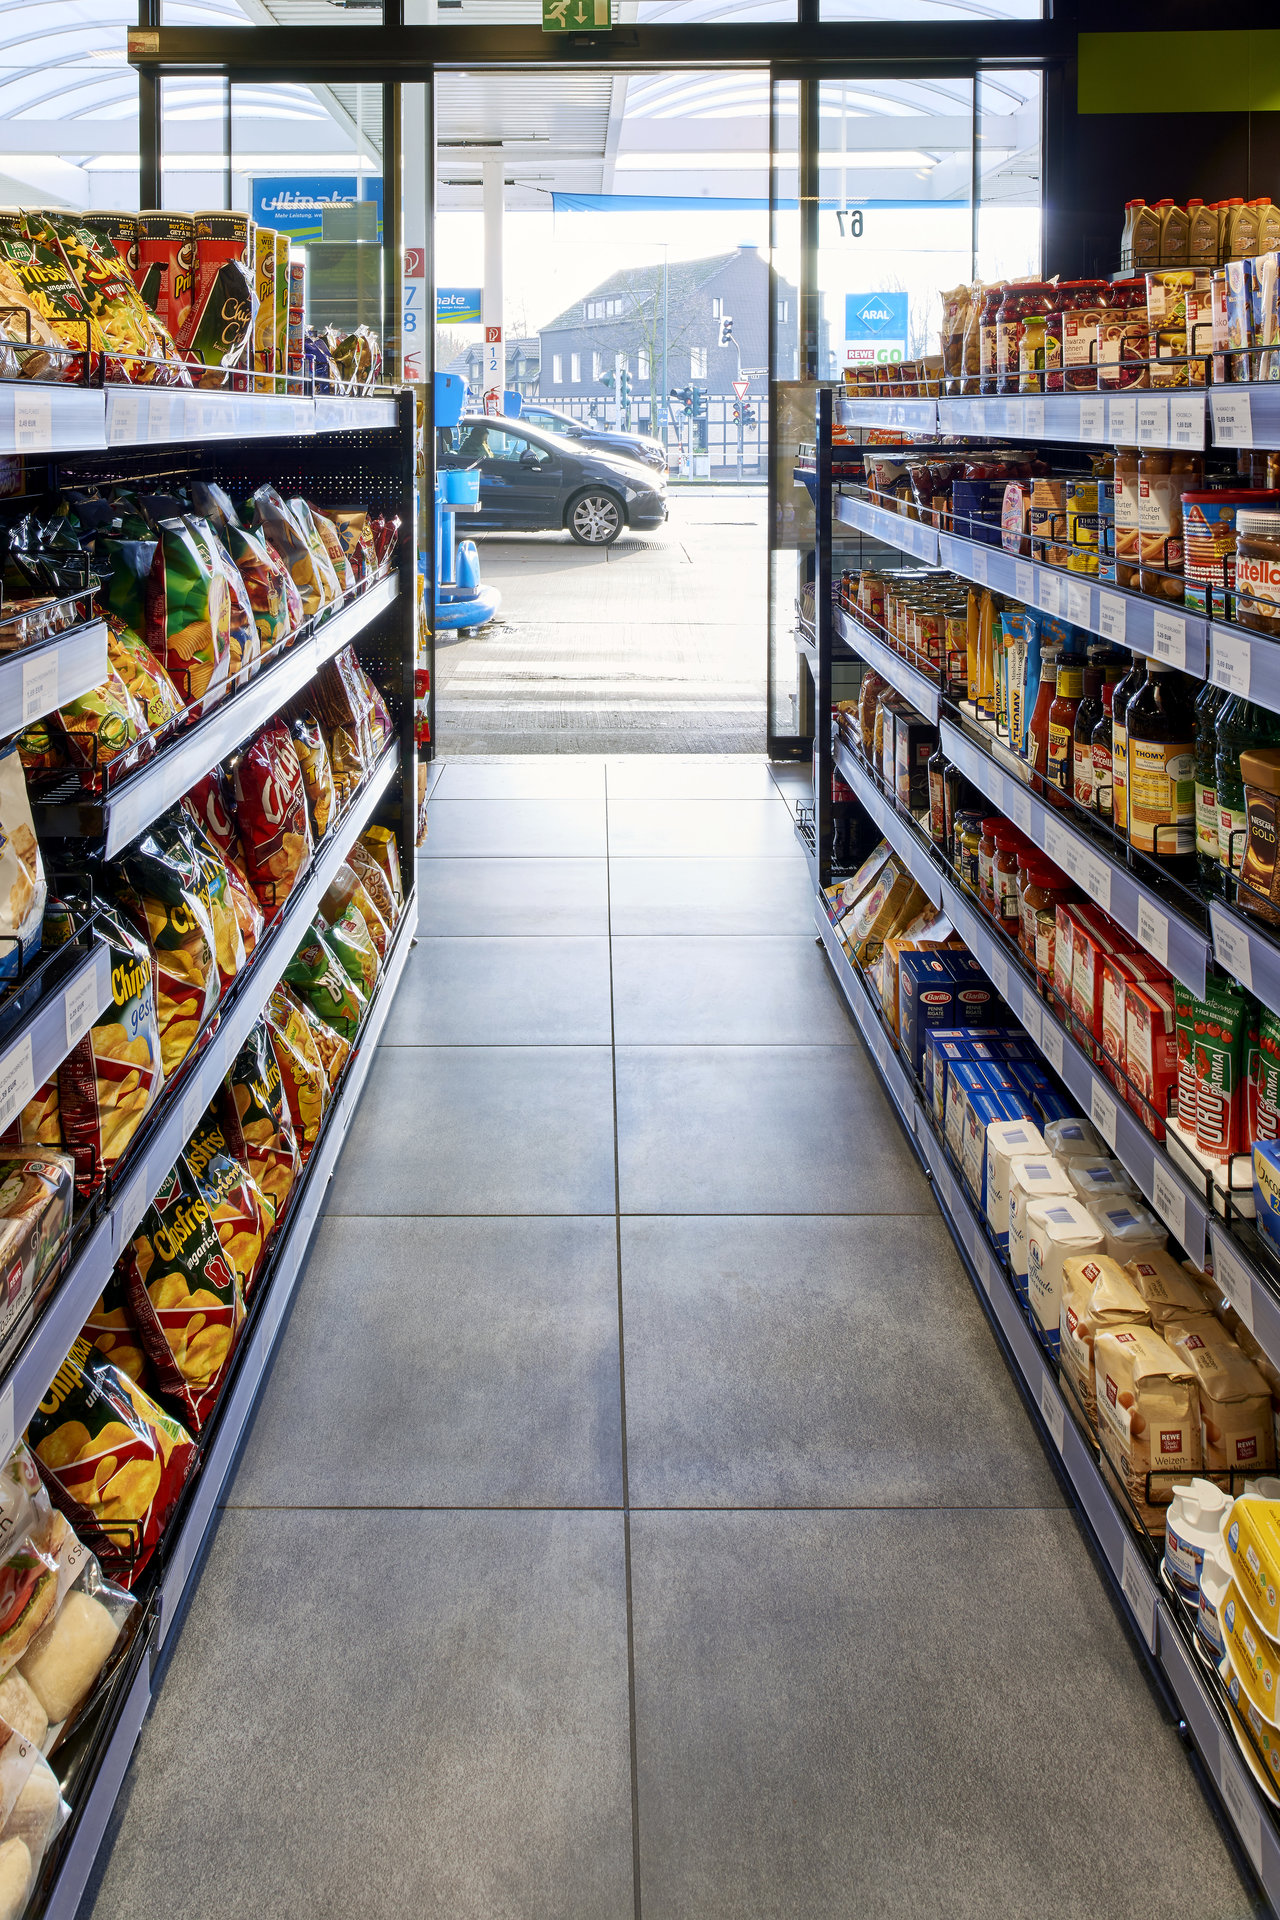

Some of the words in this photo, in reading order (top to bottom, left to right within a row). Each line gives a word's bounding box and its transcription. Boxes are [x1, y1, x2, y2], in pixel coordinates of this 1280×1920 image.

[404, 286, 416, 306] 7
[404, 312, 416, 332] 8
[862, 310, 889, 320] ARAL
[490, 347, 495, 358] 1
[877, 349, 902, 363] GO
[490, 360, 498, 370] 2
[1136, 750, 1165, 760] THOMY
[1252, 826, 1276, 844] GOLD
[927, 993, 949, 1002] Barilla
[966, 992, 988, 1001] Barilla
[1192, 994, 1240, 1018] Toatenmark
[1211, 1053, 1224, 1096] PARMA
[1202, 1080, 1211, 1094] DI
[1266, 1070, 1278, 1114] PARMA
[1197, 1093, 1224, 1144] ORO
[10, 1268, 23, 1290] REWE
[1067, 1311, 1078, 1327] REWE
[1237, 1440, 1255, 1448] REWE
[1155, 1456, 1188, 1465] Weizen-
